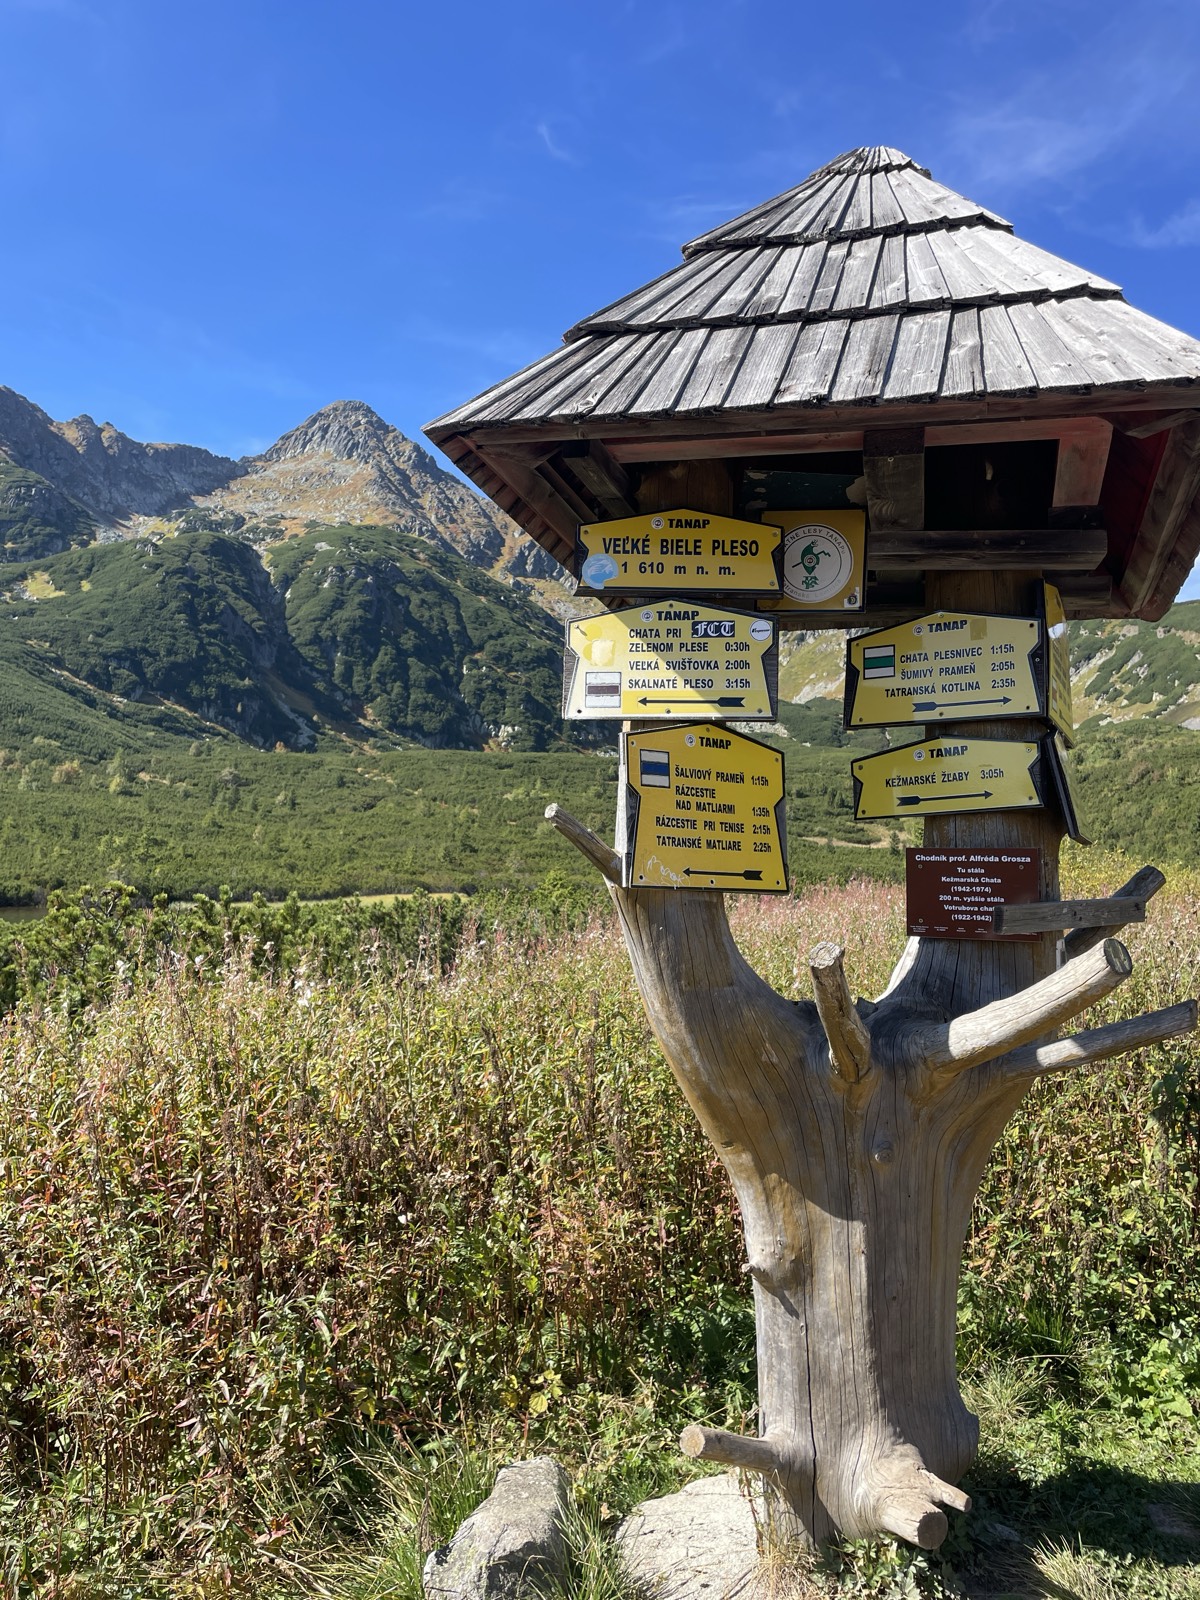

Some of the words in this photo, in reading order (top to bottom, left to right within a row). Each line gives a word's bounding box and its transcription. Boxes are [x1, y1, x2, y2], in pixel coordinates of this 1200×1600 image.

[668, 519, 710, 529] TANAP
[603, 534, 650, 555] VEĽKÉ
[660, 539, 702, 556] BIELE
[712, 539, 759, 557] PLESO
[622, 562, 628, 574] 1
[639, 562, 665, 574] 610
[674, 564, 687, 575] m
[696, 565, 709, 575] n.
[719, 565, 736, 575] m.
[656, 611, 699, 621] TANAP
[629, 629, 660, 638] CHATA
[666, 628, 681, 638] PRI
[928, 620, 968, 633] TANAP
[629, 643, 673, 652] ZELENOM
[680, 642, 709, 652] PLESE
[725, 642, 750, 652] 0:30h
[900, 652, 929, 664] CHATA
[934, 647, 983, 661] PLESNIVEC
[991, 644, 1015, 655] 1:15h
[629, 659, 660, 671] VEĽKÁ
[666, 658, 719, 671] SVIŠŤOVKA
[725, 660, 750, 670] 2:00h
[901, 668, 933, 681] ŠUMIVÝ
[939, 662, 976, 676] PRAMEŇ
[991, 662, 1015, 672] 2:05h
[628, 676, 677, 689] SKALNATÉ
[684, 679, 714, 689] PLESO
[726, 679, 750, 688] 3:15h
[885, 683, 936, 698] TATRANSKÁ
[942, 681, 981, 693] KOTLINA
[992, 678, 1016, 689] 2:35h
[699, 737, 732, 750] TANAP
[929, 746, 968, 759] TANAP
[675, 764, 712, 781] ŠALVIOVÝ
[716, 771, 745, 784] PRAMEŇ
[751, 776, 769, 787] 1:15h
[886, 772, 937, 788] KEŽMARSKÉ
[942, 770, 970, 783] ŽĽABY
[981, 769, 1004, 779] 3:05h
[676, 784, 716, 799] RÁZCESTIE
[676, 800, 691, 811] NAD
[696, 802, 735, 815] MATLIARMI
[752, 807, 770, 817] 1:35h
[656, 815, 697, 830] RÁZCESTIE
[704, 820, 716, 832] PRI
[720, 822, 745, 834] TENISE
[752, 825, 771, 835] 2:15h
[657, 834, 702, 849] TATRANSKÉ
[706, 839, 742, 851] MATLIARE
[753, 842, 771, 853] 2:25h
[915, 854, 947, 862] Chodník
[949, 855, 967, 863] prof.
[952, 914, 992, 922] (1922-1942)
